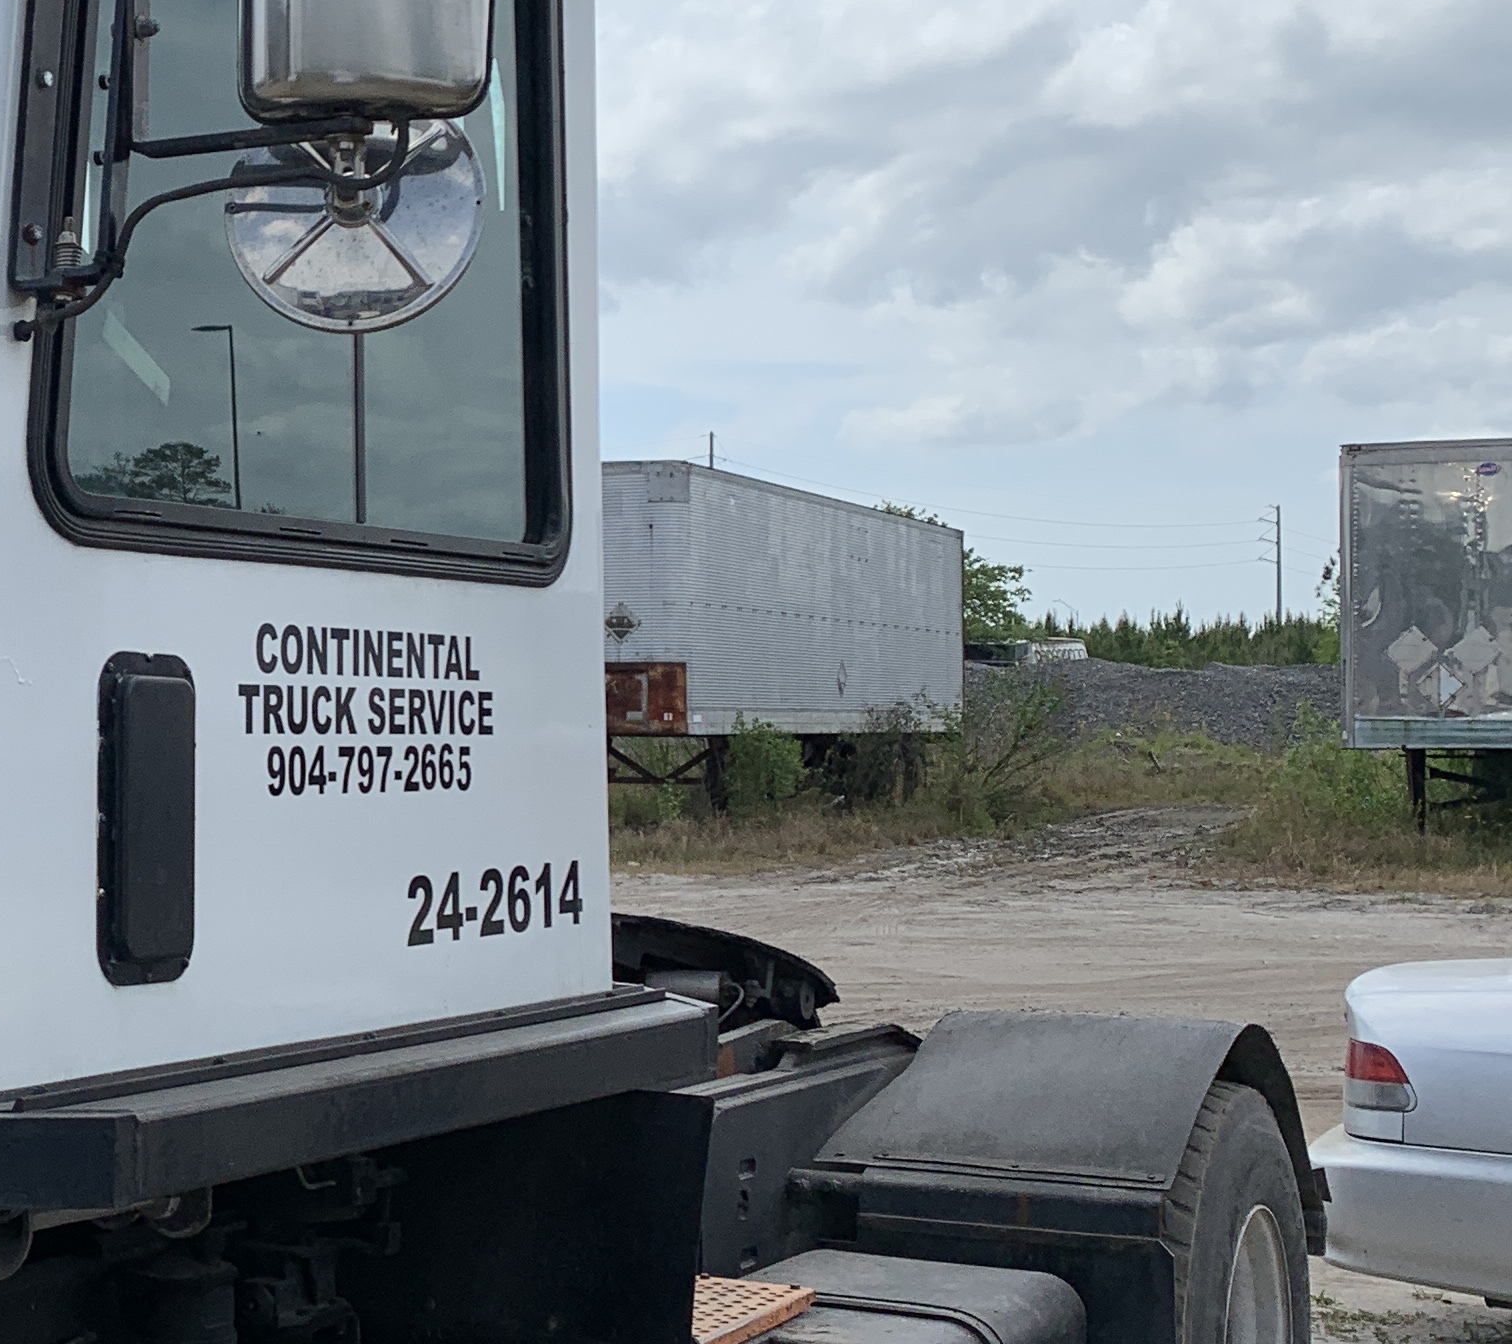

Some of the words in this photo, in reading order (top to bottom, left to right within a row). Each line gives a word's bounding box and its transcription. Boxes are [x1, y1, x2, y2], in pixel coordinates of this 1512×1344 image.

[256, 622, 480, 681] CONTINENTAL
[238, 684, 358, 735] TRUCK
[368, 687, 494, 736] SERVICE
[267, 743, 472, 796] 904-797-2665
[407, 860, 583, 947] 24-2614
